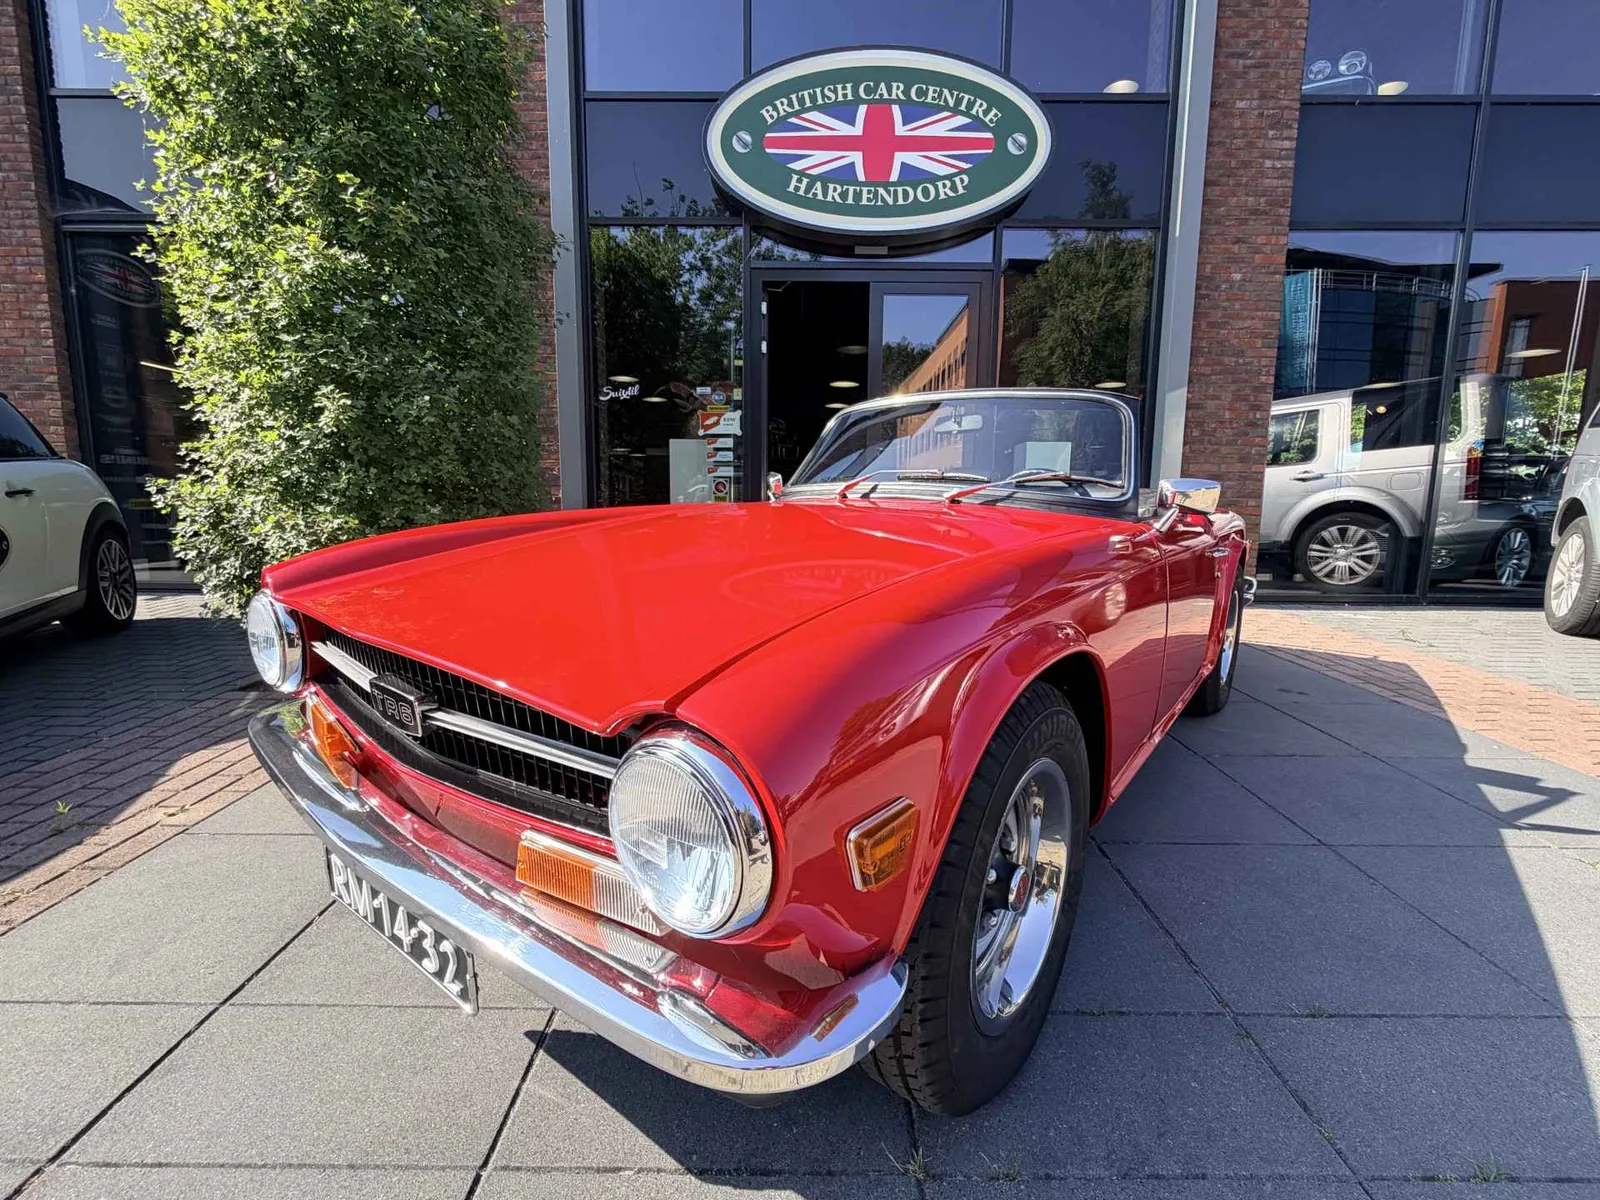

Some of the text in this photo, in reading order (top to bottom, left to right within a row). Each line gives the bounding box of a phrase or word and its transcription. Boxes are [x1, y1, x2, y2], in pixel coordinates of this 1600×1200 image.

[760, 81, 1002, 127] BRITISH CAR CENTRE
[786, 173, 969, 206] HARTENDORP
[372, 688, 414, 726] TR6
